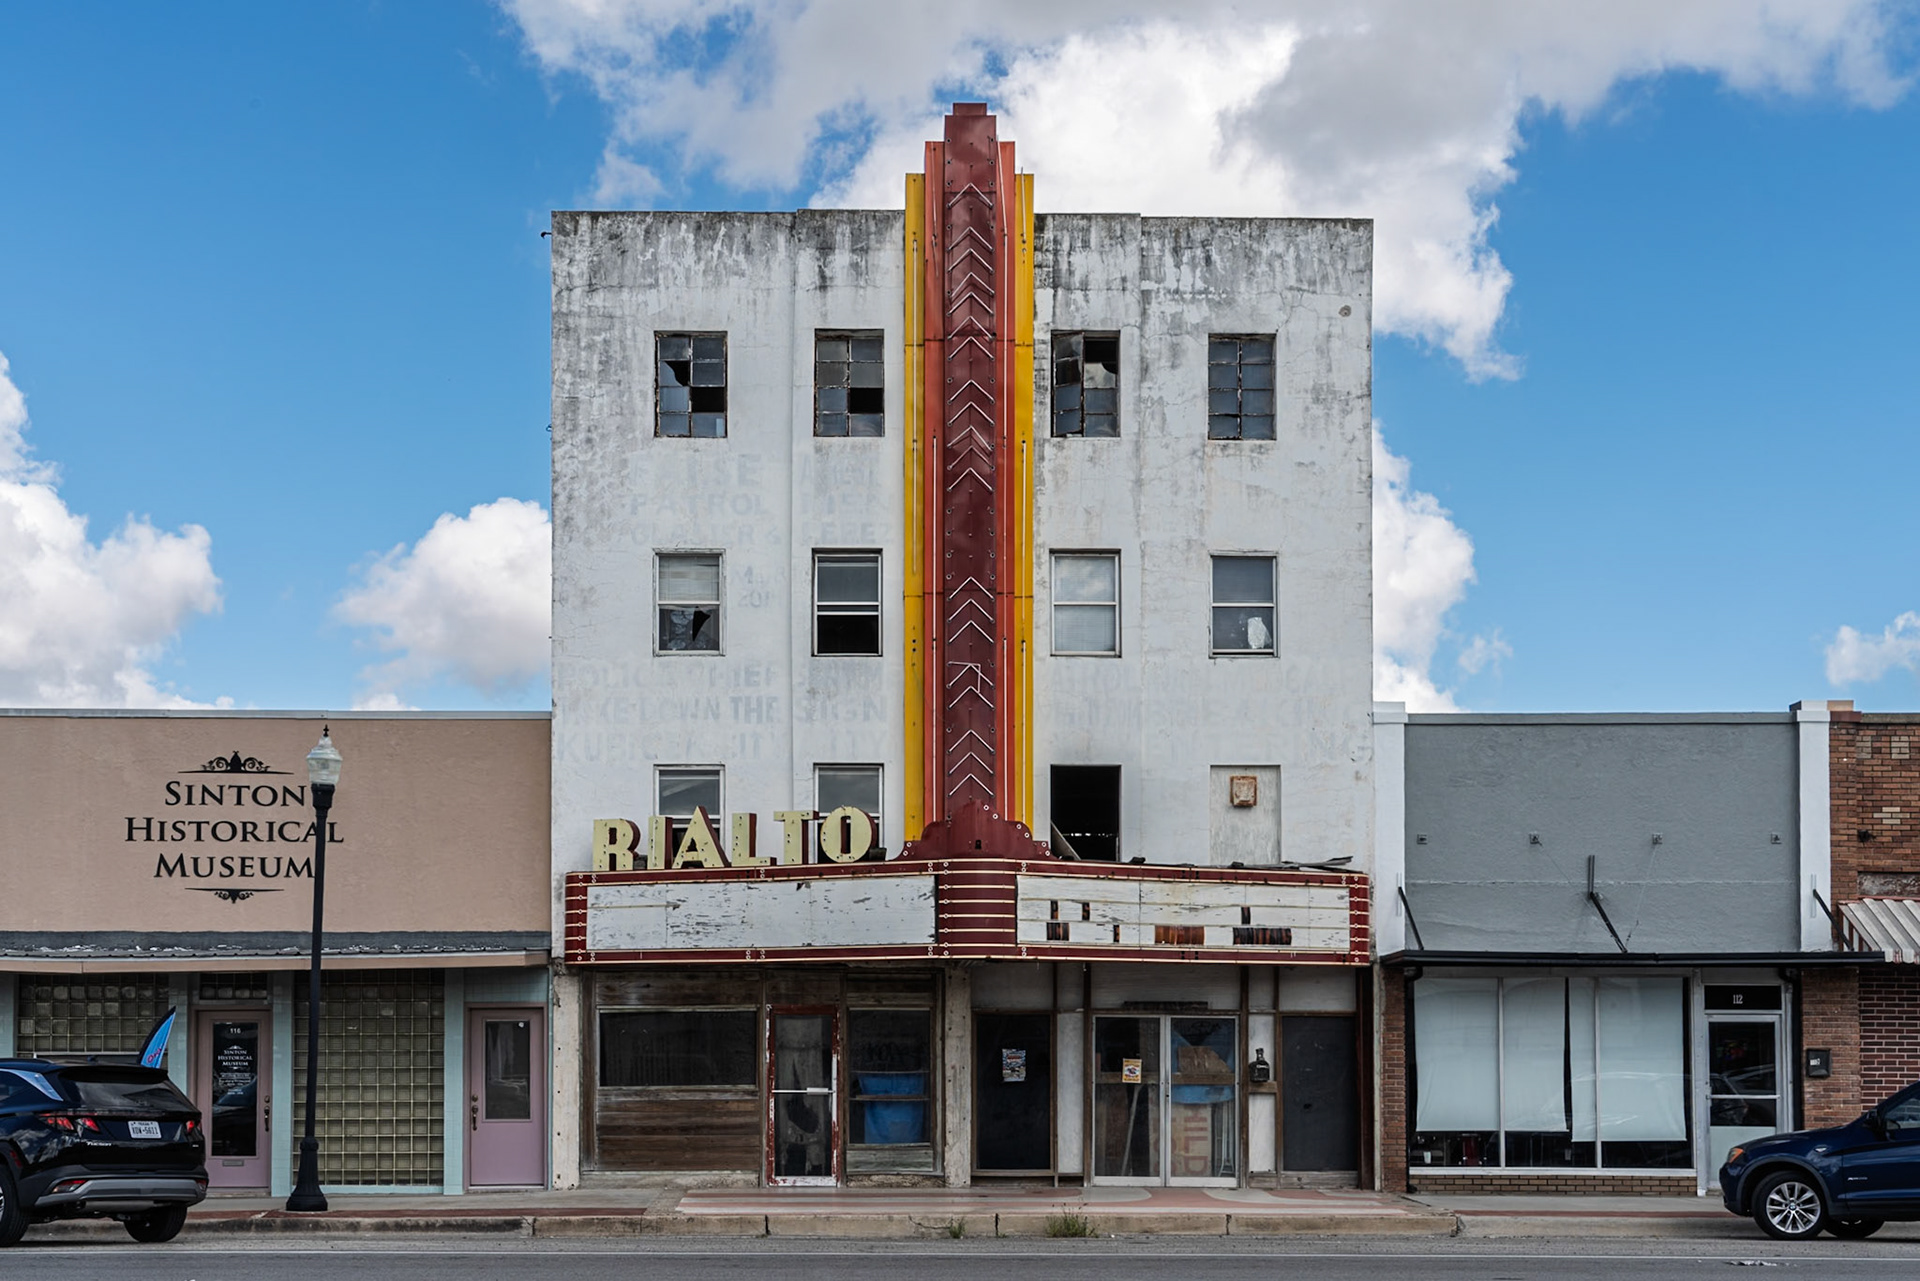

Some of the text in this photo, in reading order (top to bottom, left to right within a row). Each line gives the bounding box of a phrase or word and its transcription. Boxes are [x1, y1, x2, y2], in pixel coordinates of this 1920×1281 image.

[164, 780, 306, 807] SINTON
[124, 817, 345, 844] HISTORICAL
[592, 805, 877, 871] RIALTO
[153, 852, 316, 879] MUSEUM
[1733, 994, 1743, 1004] 112
[230, 1027, 242, 1035] 116
